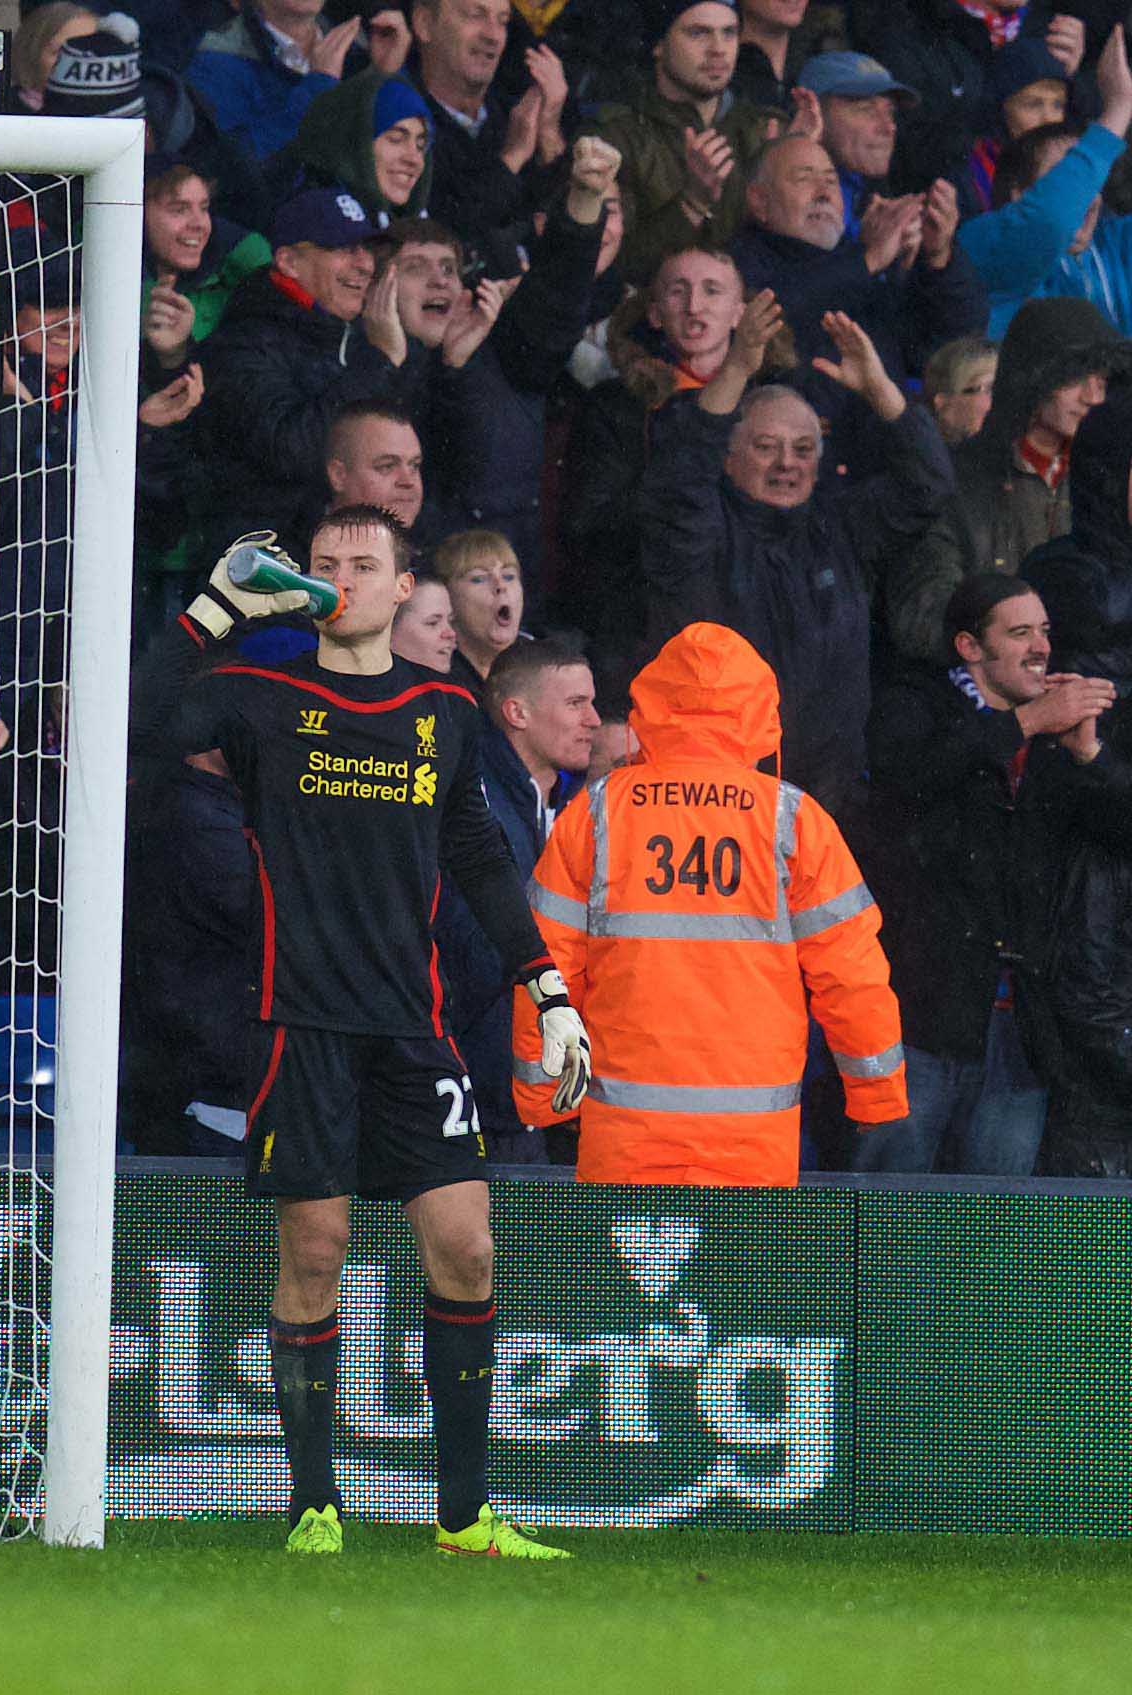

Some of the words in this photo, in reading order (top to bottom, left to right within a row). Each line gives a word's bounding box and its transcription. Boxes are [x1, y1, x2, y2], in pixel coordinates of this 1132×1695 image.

[308, 751, 409, 779] Standard
[299, 774, 408, 803] Chartered
[631, 782, 756, 811] STEWARD
[645, 834, 741, 897] 340
